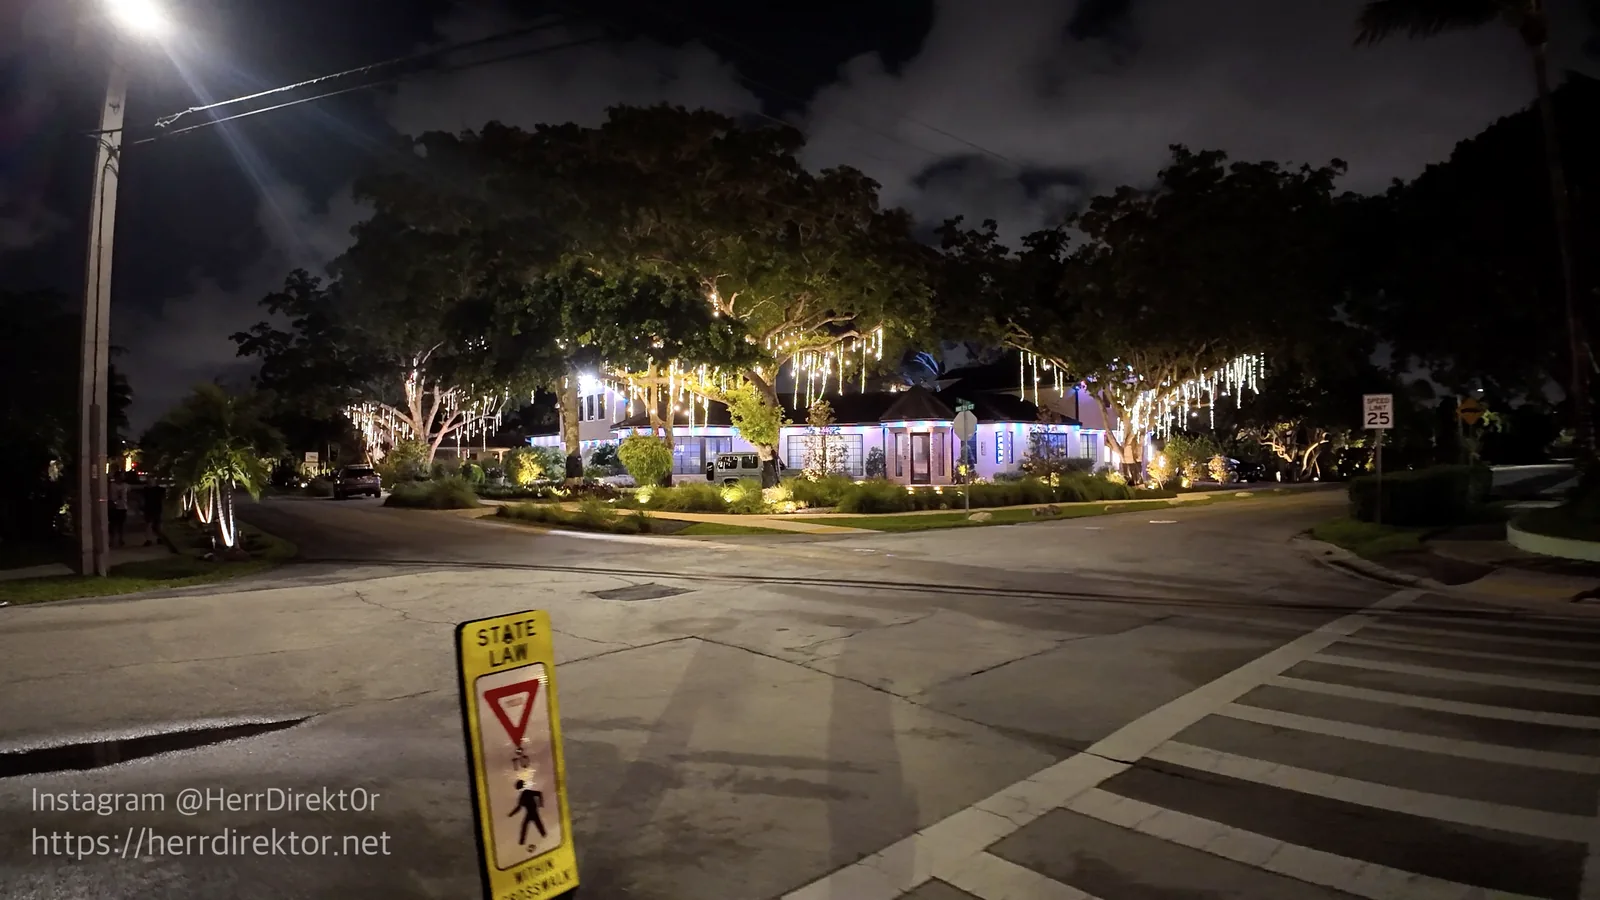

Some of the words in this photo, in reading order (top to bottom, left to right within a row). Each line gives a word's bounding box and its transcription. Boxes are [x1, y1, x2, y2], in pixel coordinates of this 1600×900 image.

[1367, 412, 1390, 425] 25
[476, 619, 537, 647] STATE
[489, 643, 528, 667] LAW
[511, 754, 530, 771] TO
